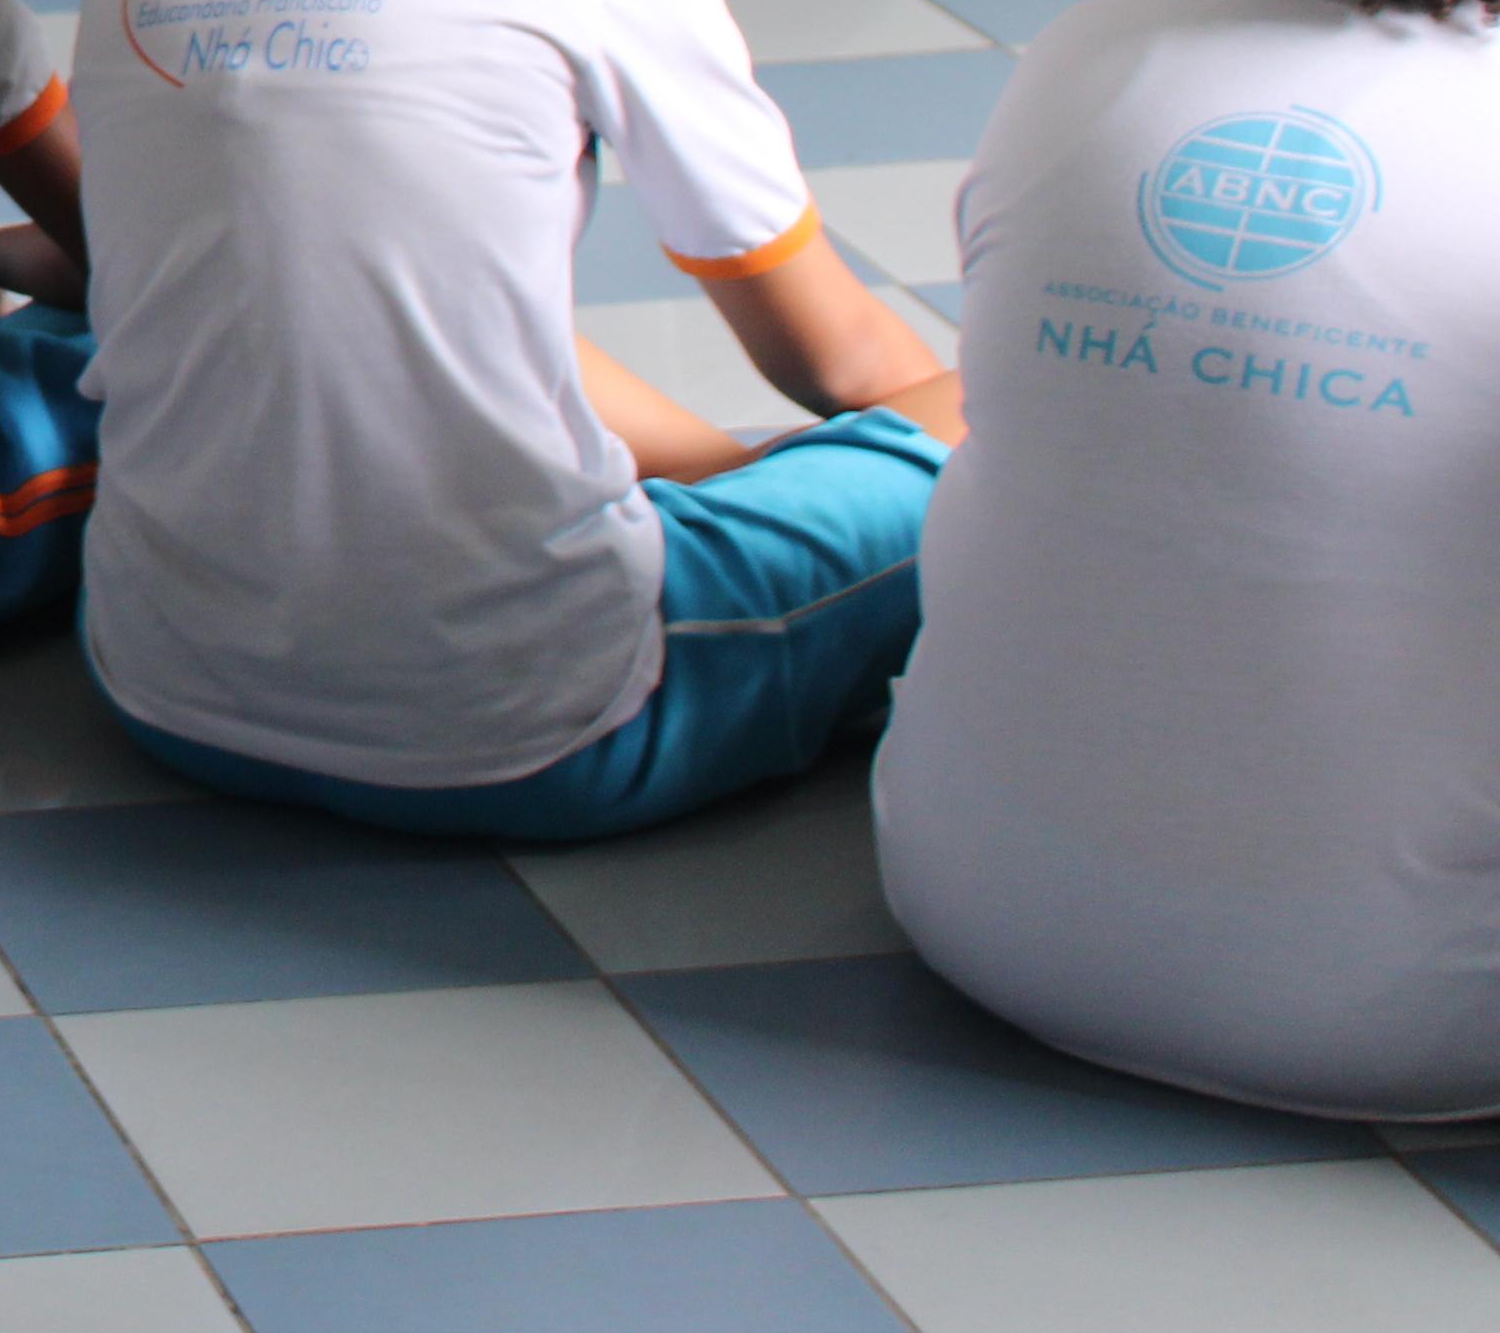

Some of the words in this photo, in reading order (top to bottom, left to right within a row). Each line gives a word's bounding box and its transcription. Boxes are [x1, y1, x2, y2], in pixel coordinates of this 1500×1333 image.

[182, 27, 252, 76] Nhá
[1169, 165, 1345, 219] ABNC
[1043, 279, 1201, 322] ASSOCIAÇÃO
[1211, 305, 1432, 361] BENEFICENTE
[1035, 317, 1160, 375] NHÁ
[1190, 346, 1417, 419] CHICA
